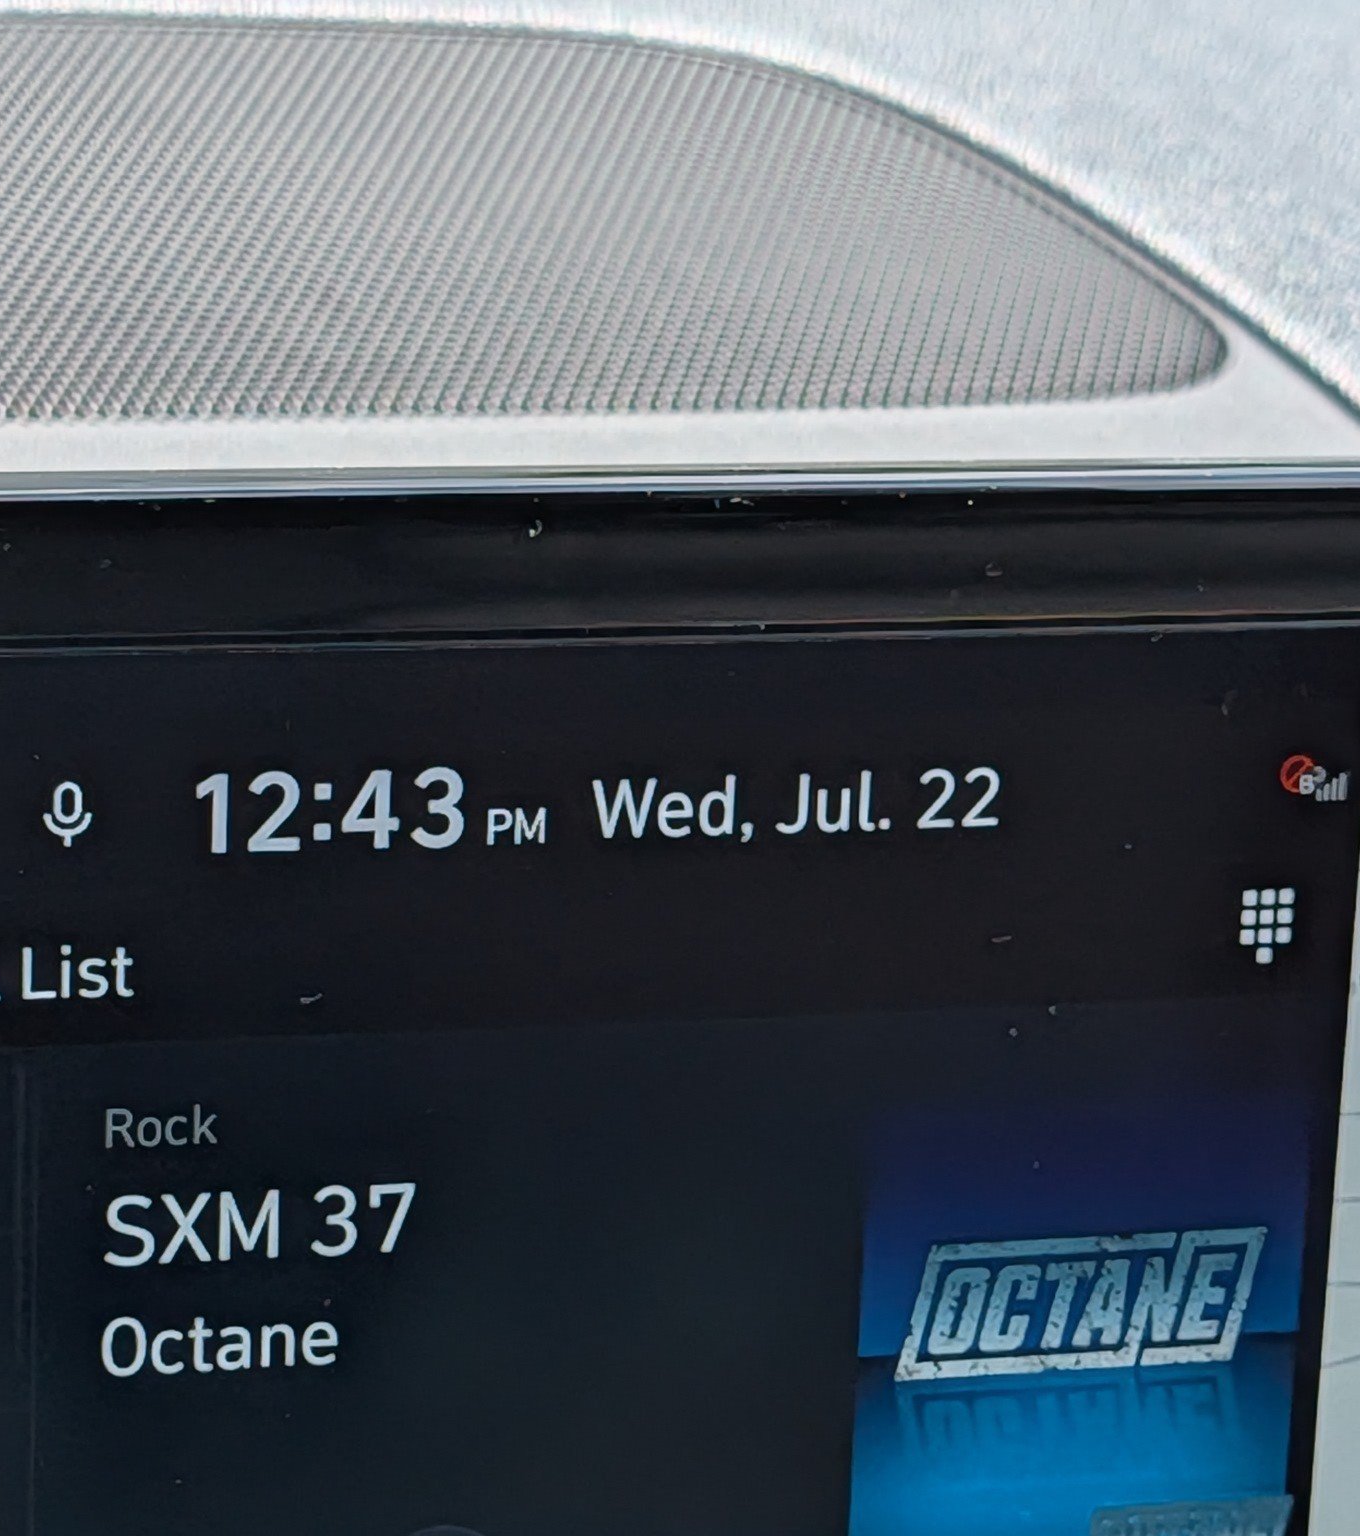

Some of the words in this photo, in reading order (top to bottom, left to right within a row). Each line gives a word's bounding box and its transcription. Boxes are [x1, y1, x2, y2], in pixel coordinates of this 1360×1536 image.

[195, 766, 465, 854] 12:43
[486, 806, 547, 846] PM
[592, 774, 754, 843] Wed,
[775, 769, 891, 835] Jul.
[916, 766, 1000, 829] 22
[21, 944, 135, 1000] List
[105, 1103, 218, 1149] Rock
[103, 1189, 280, 1267] SXM
[310, 1182, 416, 1257] 37
[928, 1251, 1237, 1355] OCTANE
[101, 1316, 339, 1377] Octane
